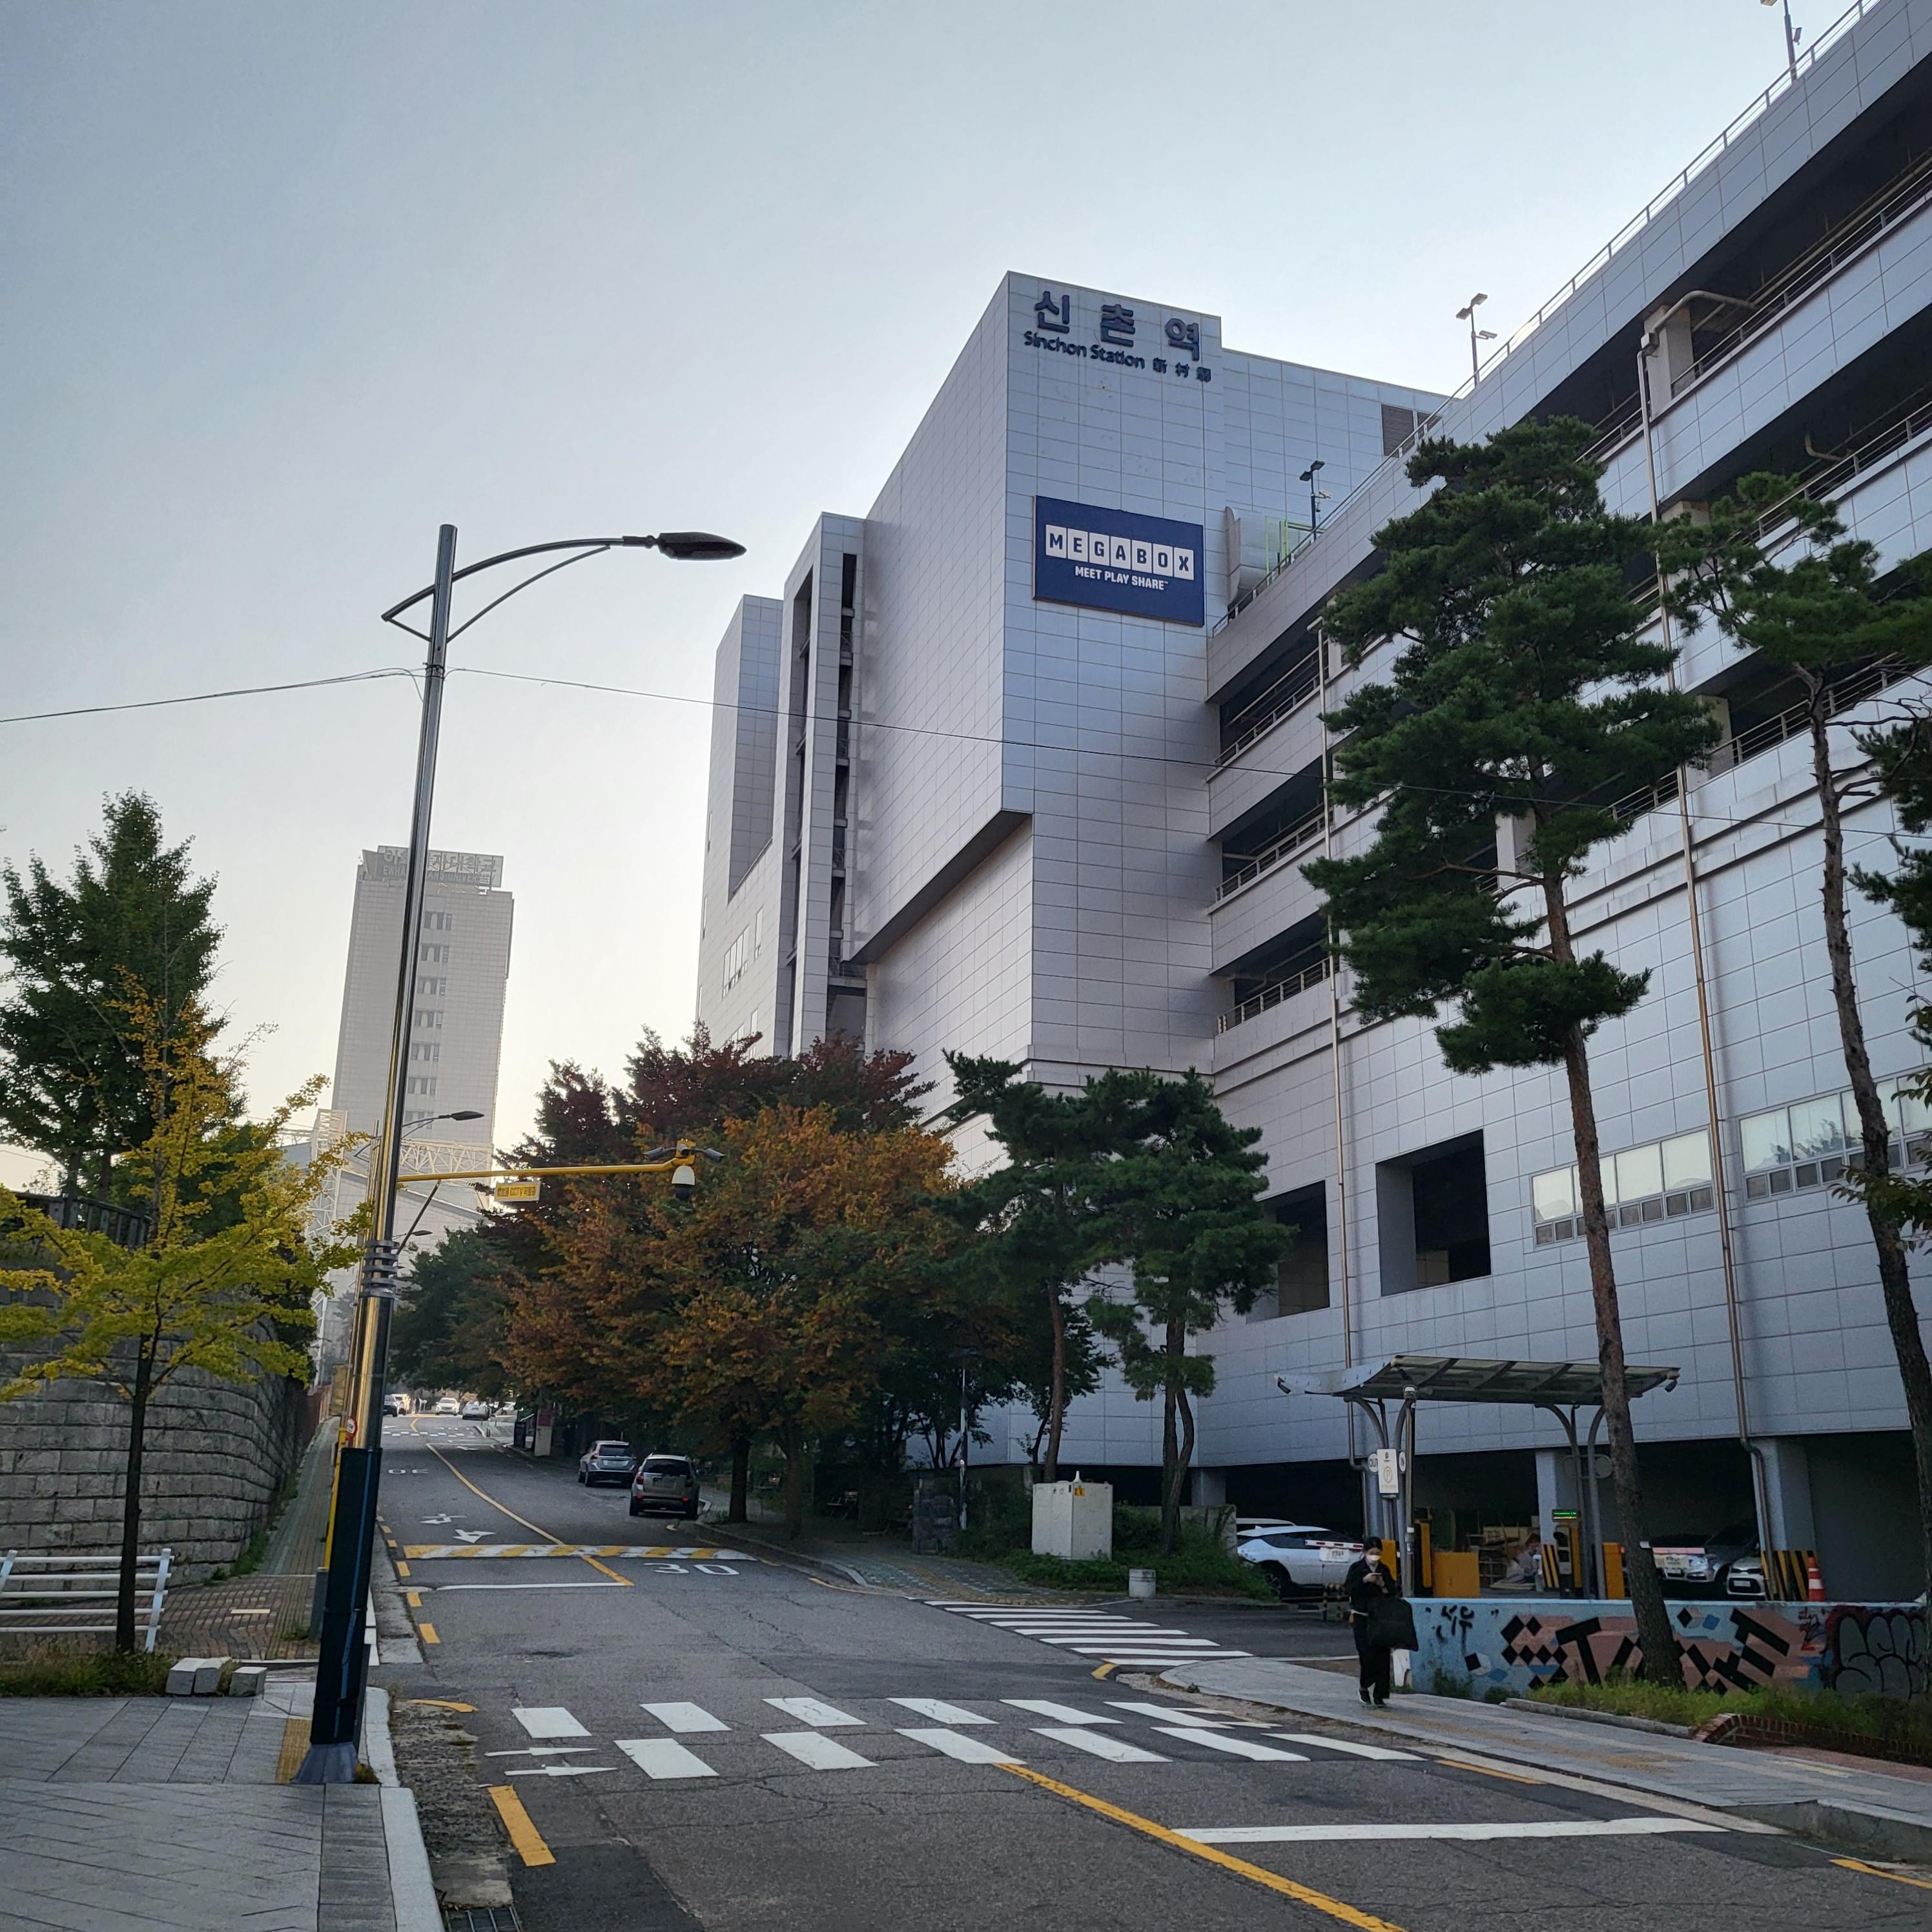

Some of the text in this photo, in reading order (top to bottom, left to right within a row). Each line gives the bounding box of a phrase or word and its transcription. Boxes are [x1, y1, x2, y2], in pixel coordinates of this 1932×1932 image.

[1034, 291, 1200, 361] 신촌역
[1023, 331, 1087, 357] Sinchon
[1090, 344, 1146, 369] Station
[1049, 532, 1189, 572] MEGABOX
[1074, 566, 1102, 580] MEET
[1104, 571, 1130, 585] PLAY
[642, 1562, 739, 1576] 30
